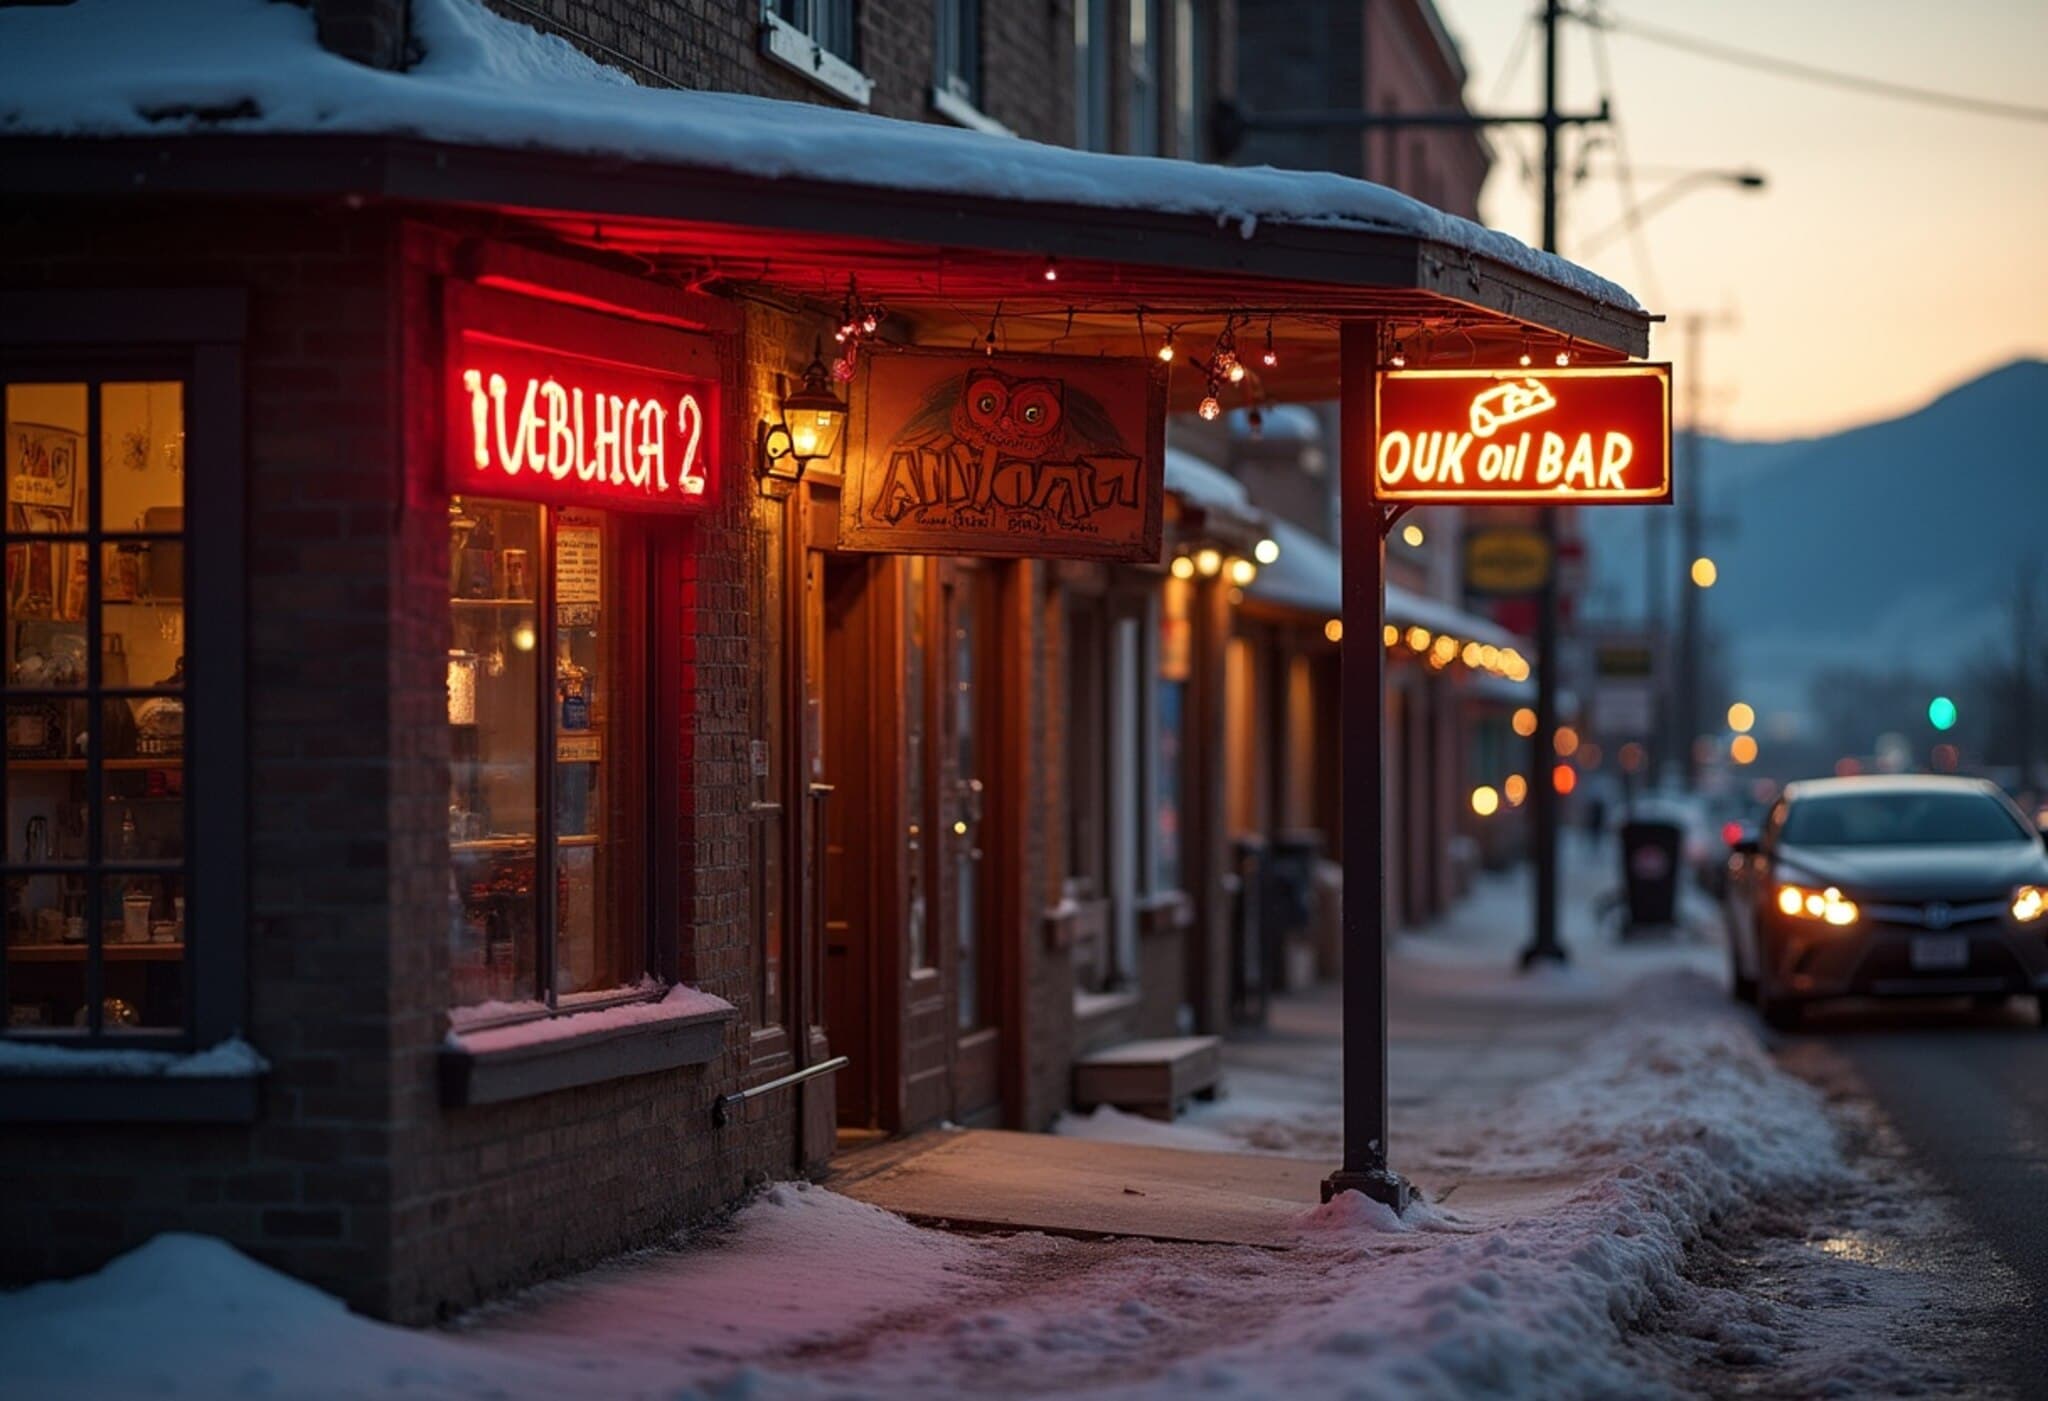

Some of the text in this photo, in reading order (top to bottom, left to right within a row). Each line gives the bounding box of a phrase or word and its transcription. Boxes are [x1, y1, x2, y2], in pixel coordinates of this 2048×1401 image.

[678, 394, 707, 495] 2
[1379, 431, 1473, 484] OUK
[1536, 431, 1633, 489] BAR
